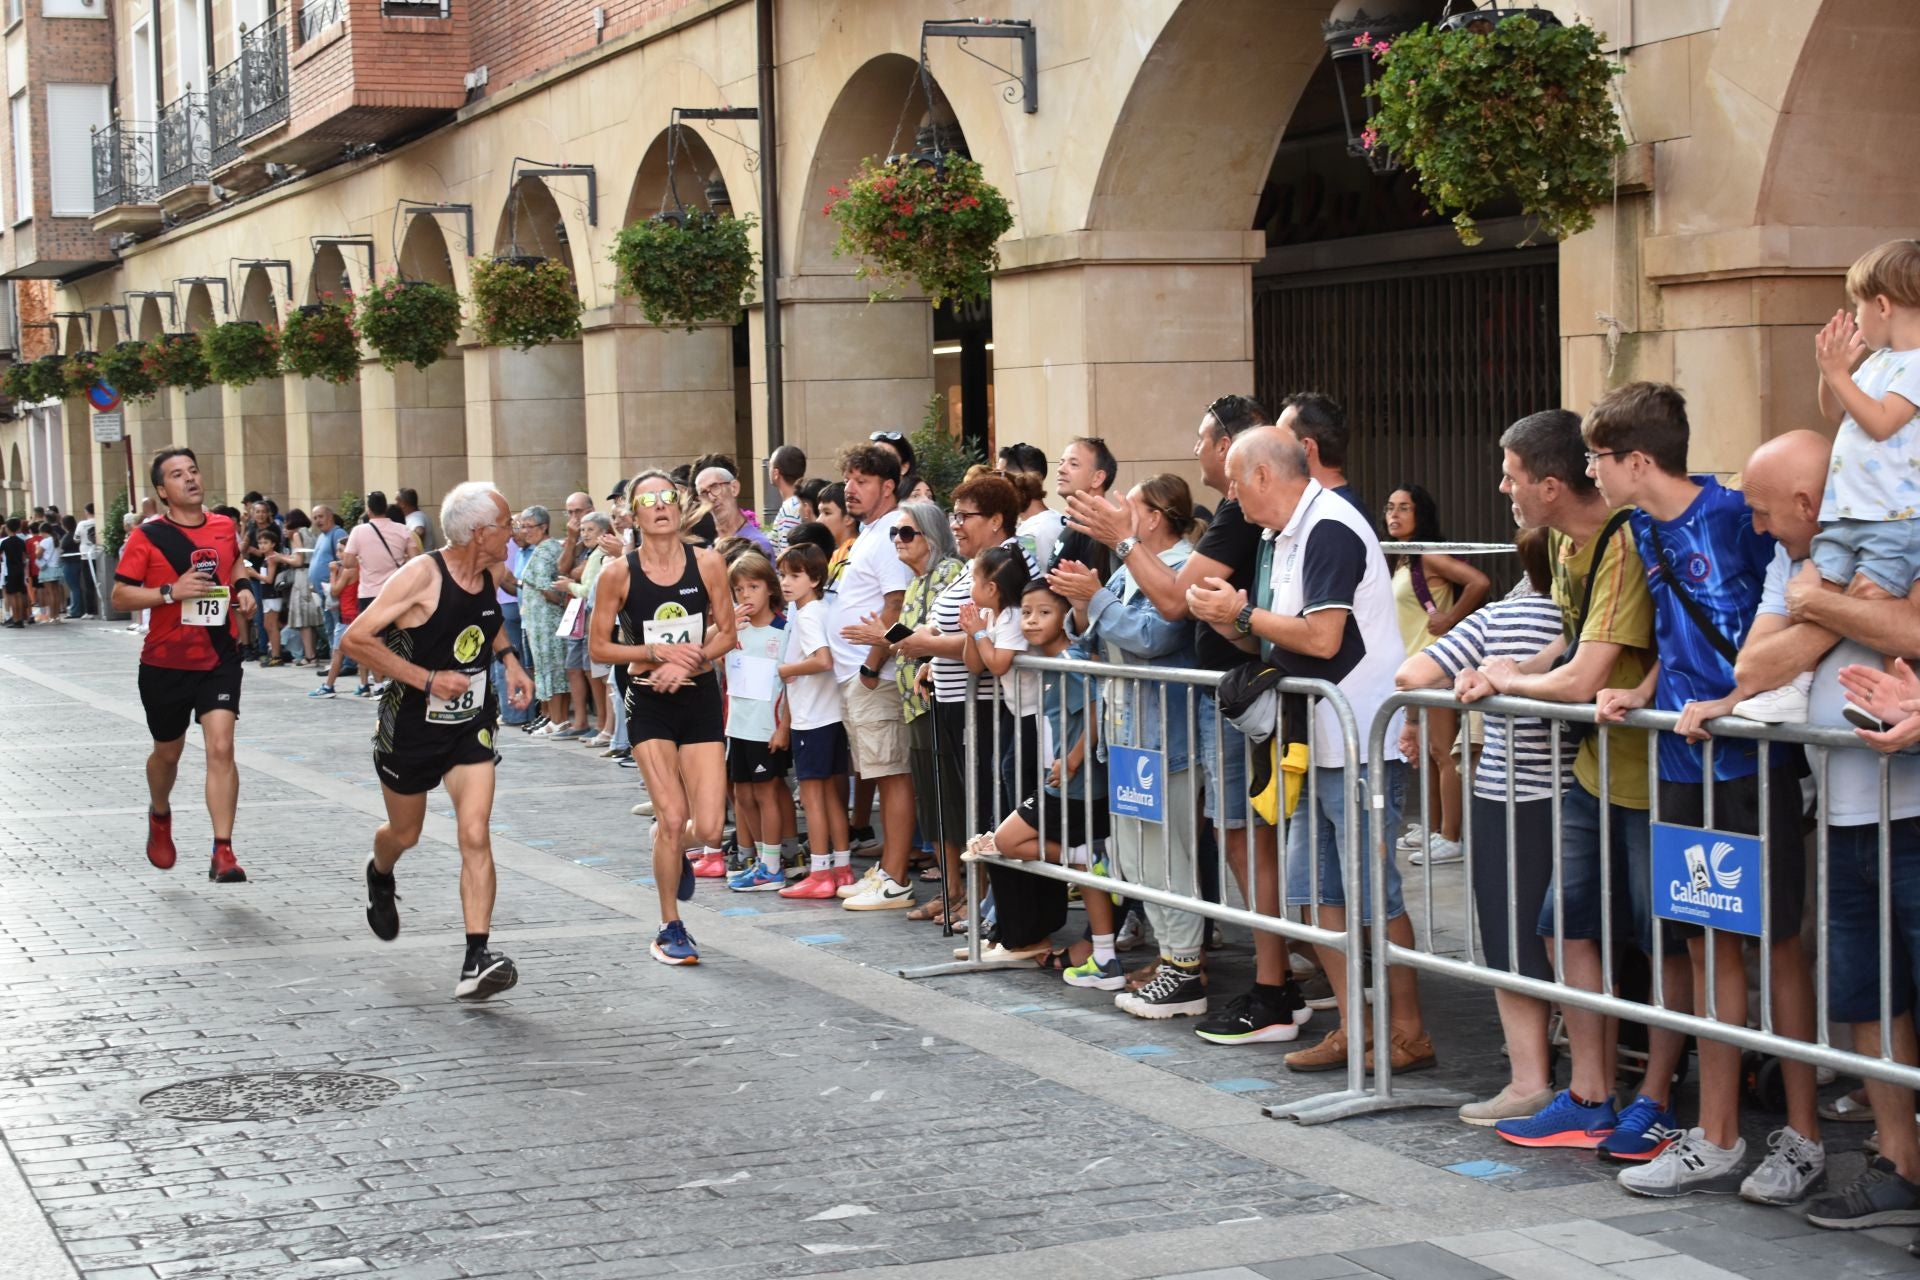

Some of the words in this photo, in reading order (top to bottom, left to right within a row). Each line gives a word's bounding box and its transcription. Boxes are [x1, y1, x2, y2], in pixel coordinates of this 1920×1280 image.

[196, 600, 219, 616] 173
[660, 630, 691, 644] 34
[445, 690, 474, 711] 38
[1116, 785, 1154, 807] Calahorra
